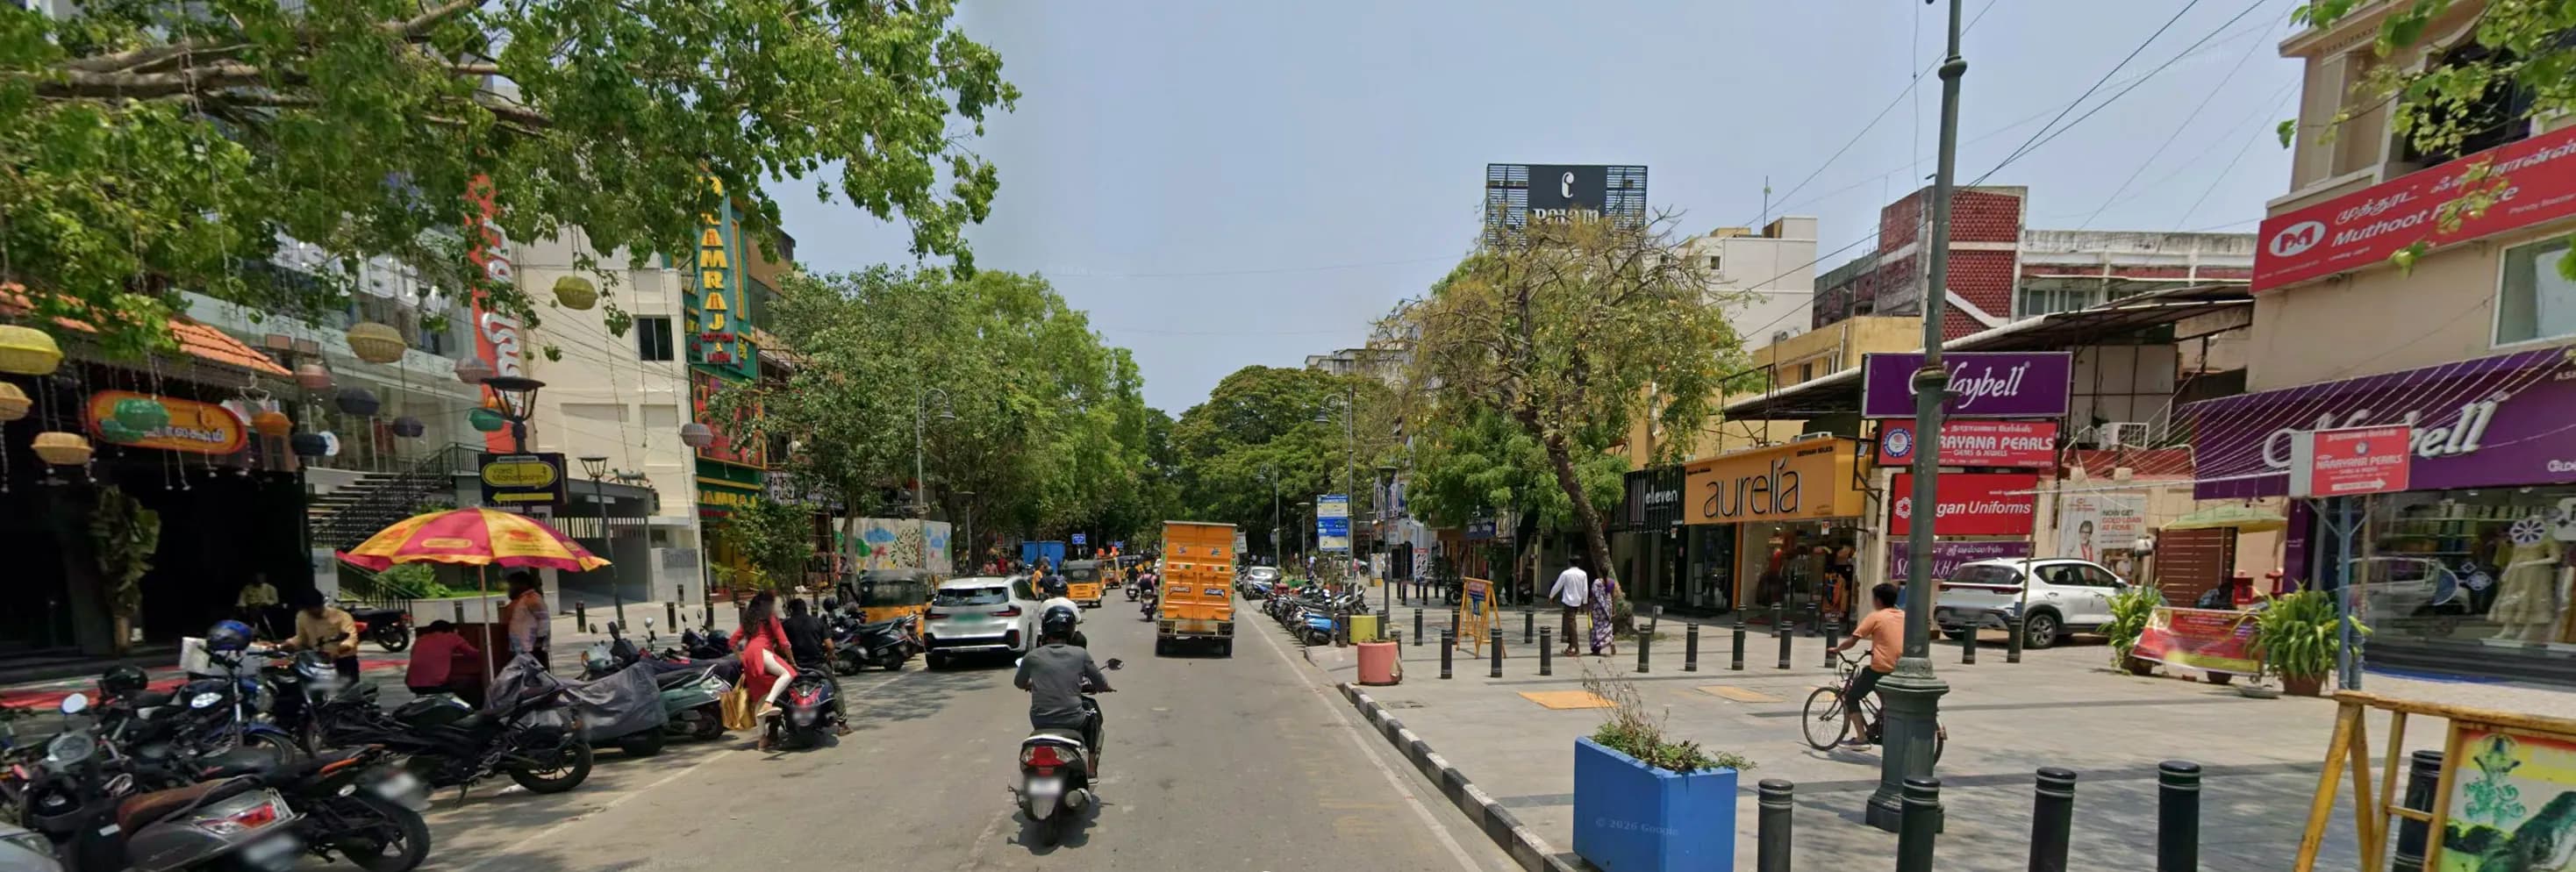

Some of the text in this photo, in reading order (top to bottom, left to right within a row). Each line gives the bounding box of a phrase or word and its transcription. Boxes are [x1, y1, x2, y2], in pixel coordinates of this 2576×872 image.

[2330, 209, 2429, 247] Muthoot
[1940, 435, 2054, 451] RAYANA PEARLS
[1645, 483, 1678, 504] eleven
[1968, 500, 2032, 514] Uniforms
